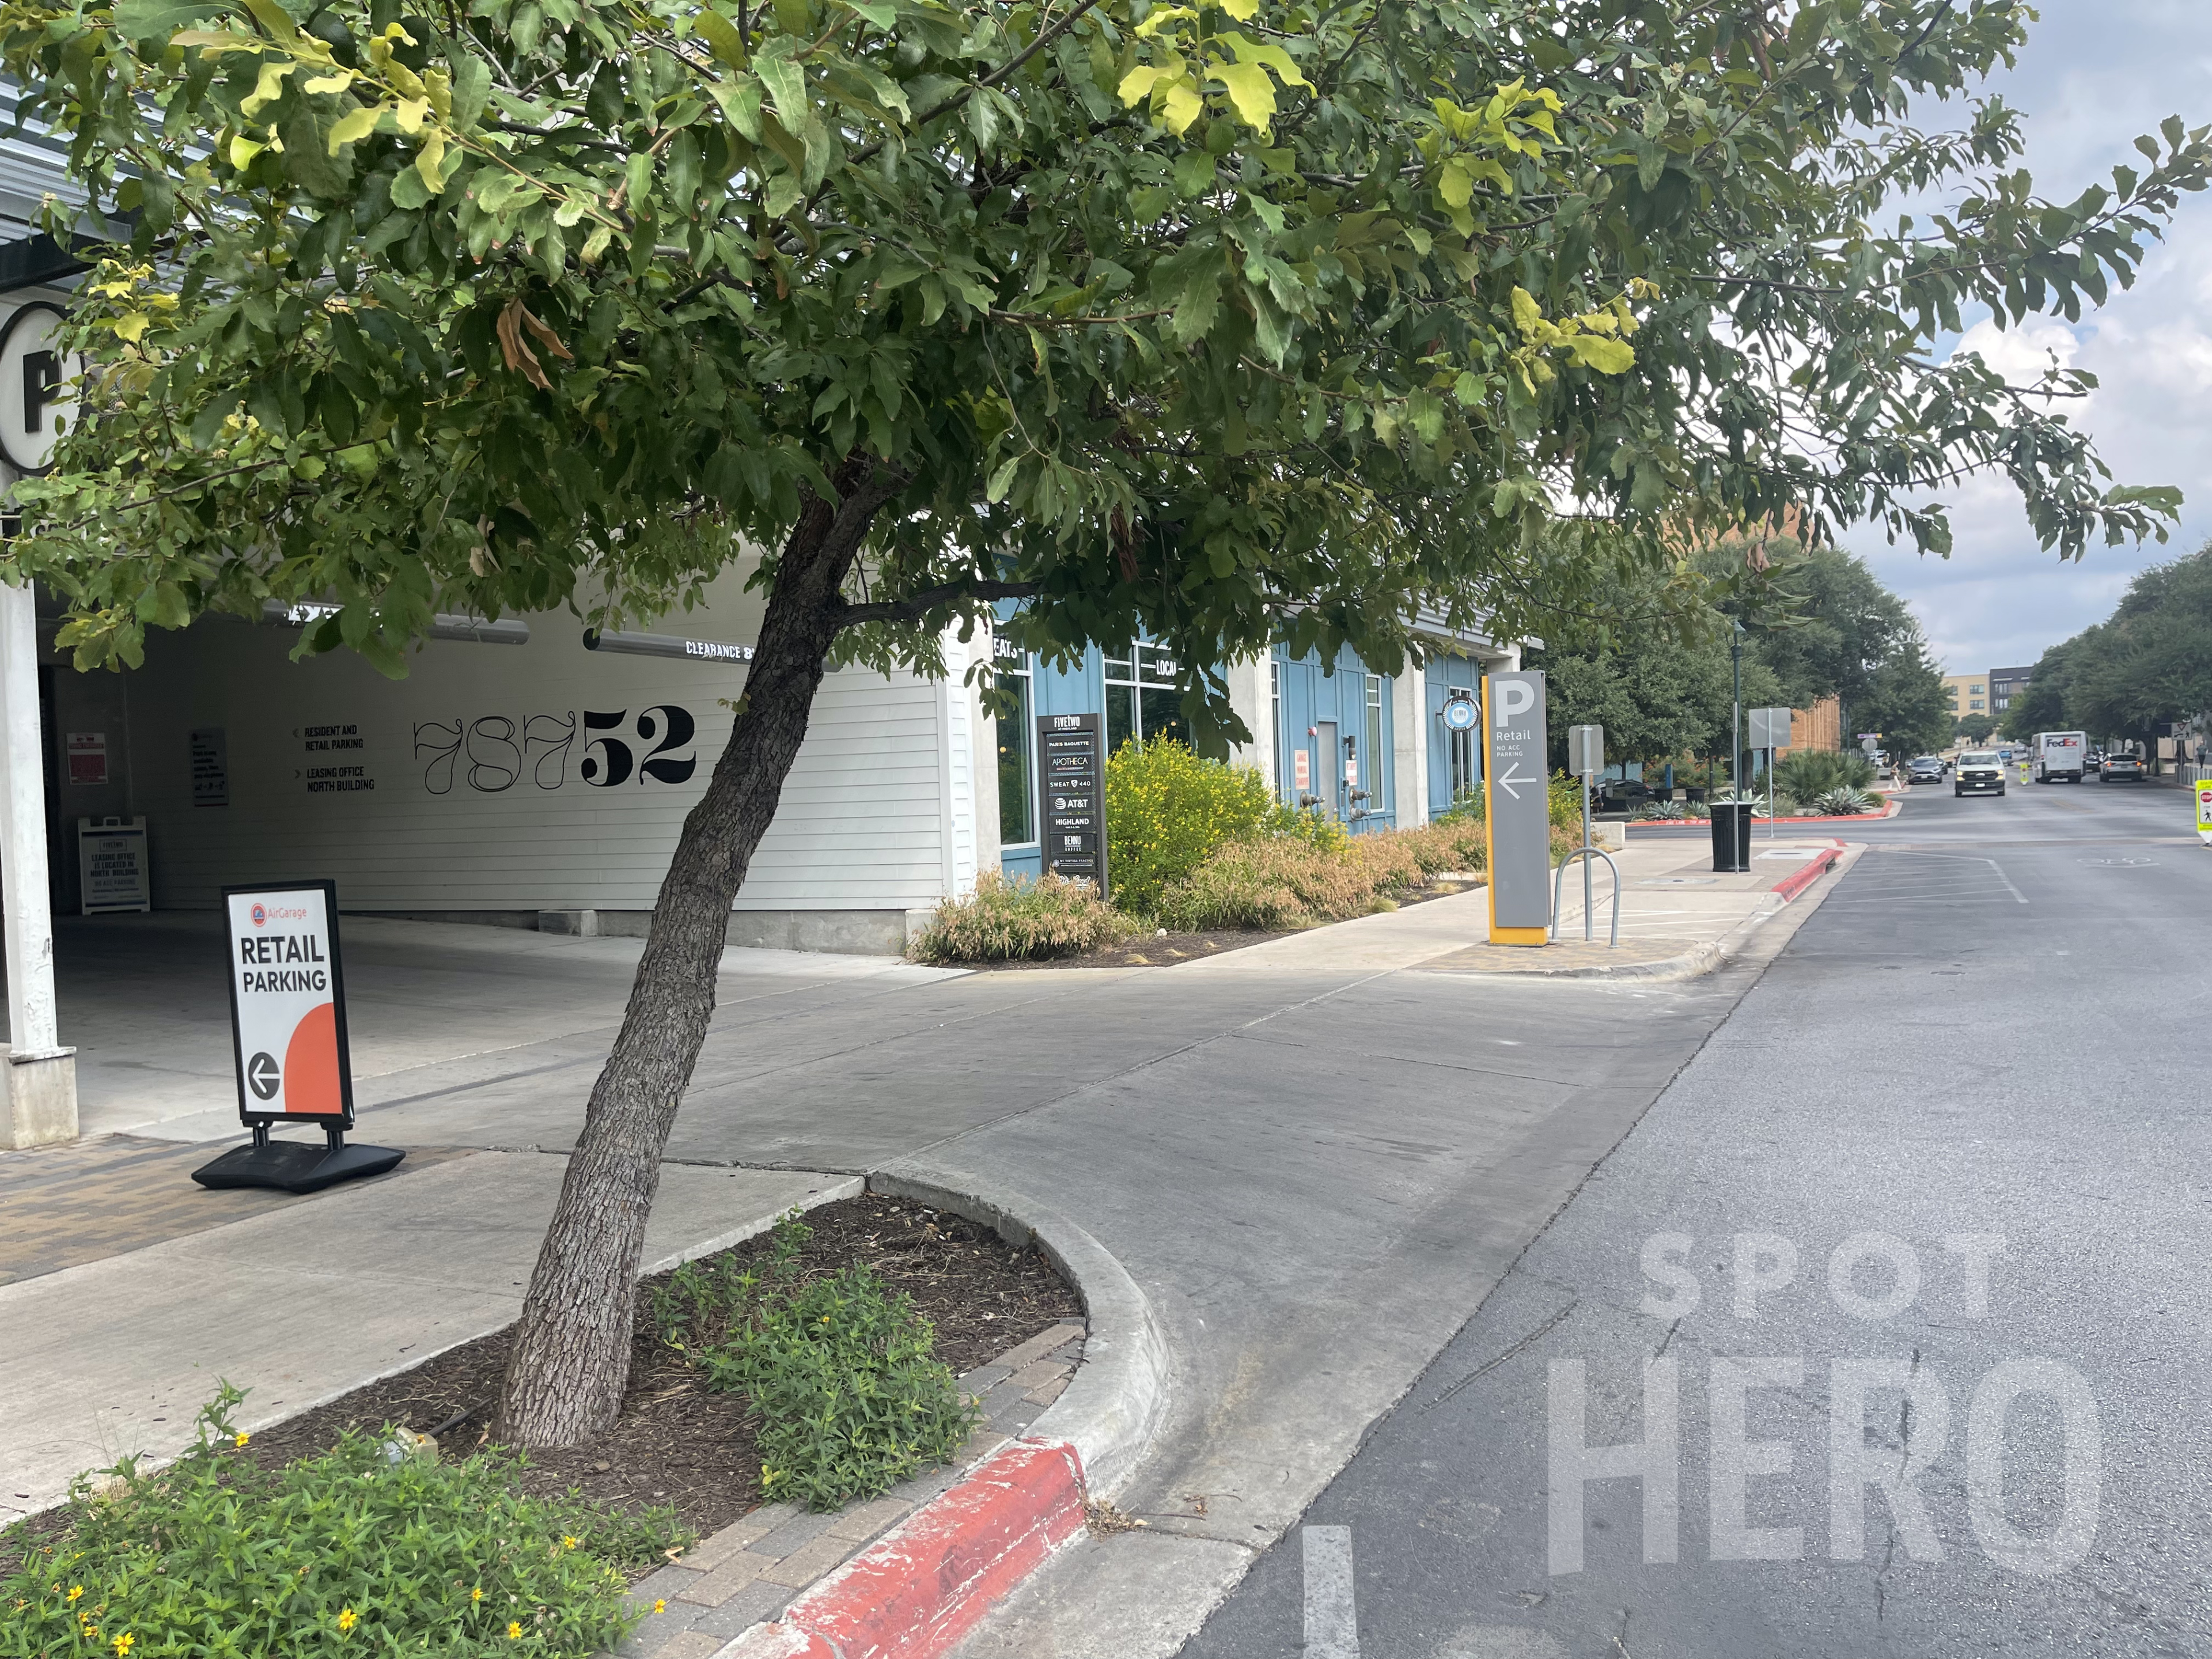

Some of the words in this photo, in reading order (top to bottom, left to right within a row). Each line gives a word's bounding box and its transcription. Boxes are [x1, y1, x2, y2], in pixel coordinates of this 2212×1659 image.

[23, 350, 62, 433] P
[685, 641, 741, 658] CLEARANCE
[1495, 680, 1535, 728] P
[305, 726, 340, 737] RESIDENT
[342, 725, 357, 735] AND
[1497, 730, 1531, 741] Retail
[305, 740, 330, 751] RETAIL
[332, 738, 363, 749] PARKING
[2047, 738, 2078, 747] FedEx
[413, 705, 696, 795] 78752
[1052, 757, 1088, 766] APOTHECA
[307, 767, 337, 779] LEASING
[339, 766, 364, 777] OFFICE
[307, 780, 335, 793] NORTH
[337, 779, 374, 791] BUILDING
[1067, 799, 1088, 808] AT&T
[1064, 835, 1081, 845] BENNU
[268, 907, 307, 920] AirGarage
[241, 934, 324, 964] RETAIL
[243, 969, 327, 993] PARKING
